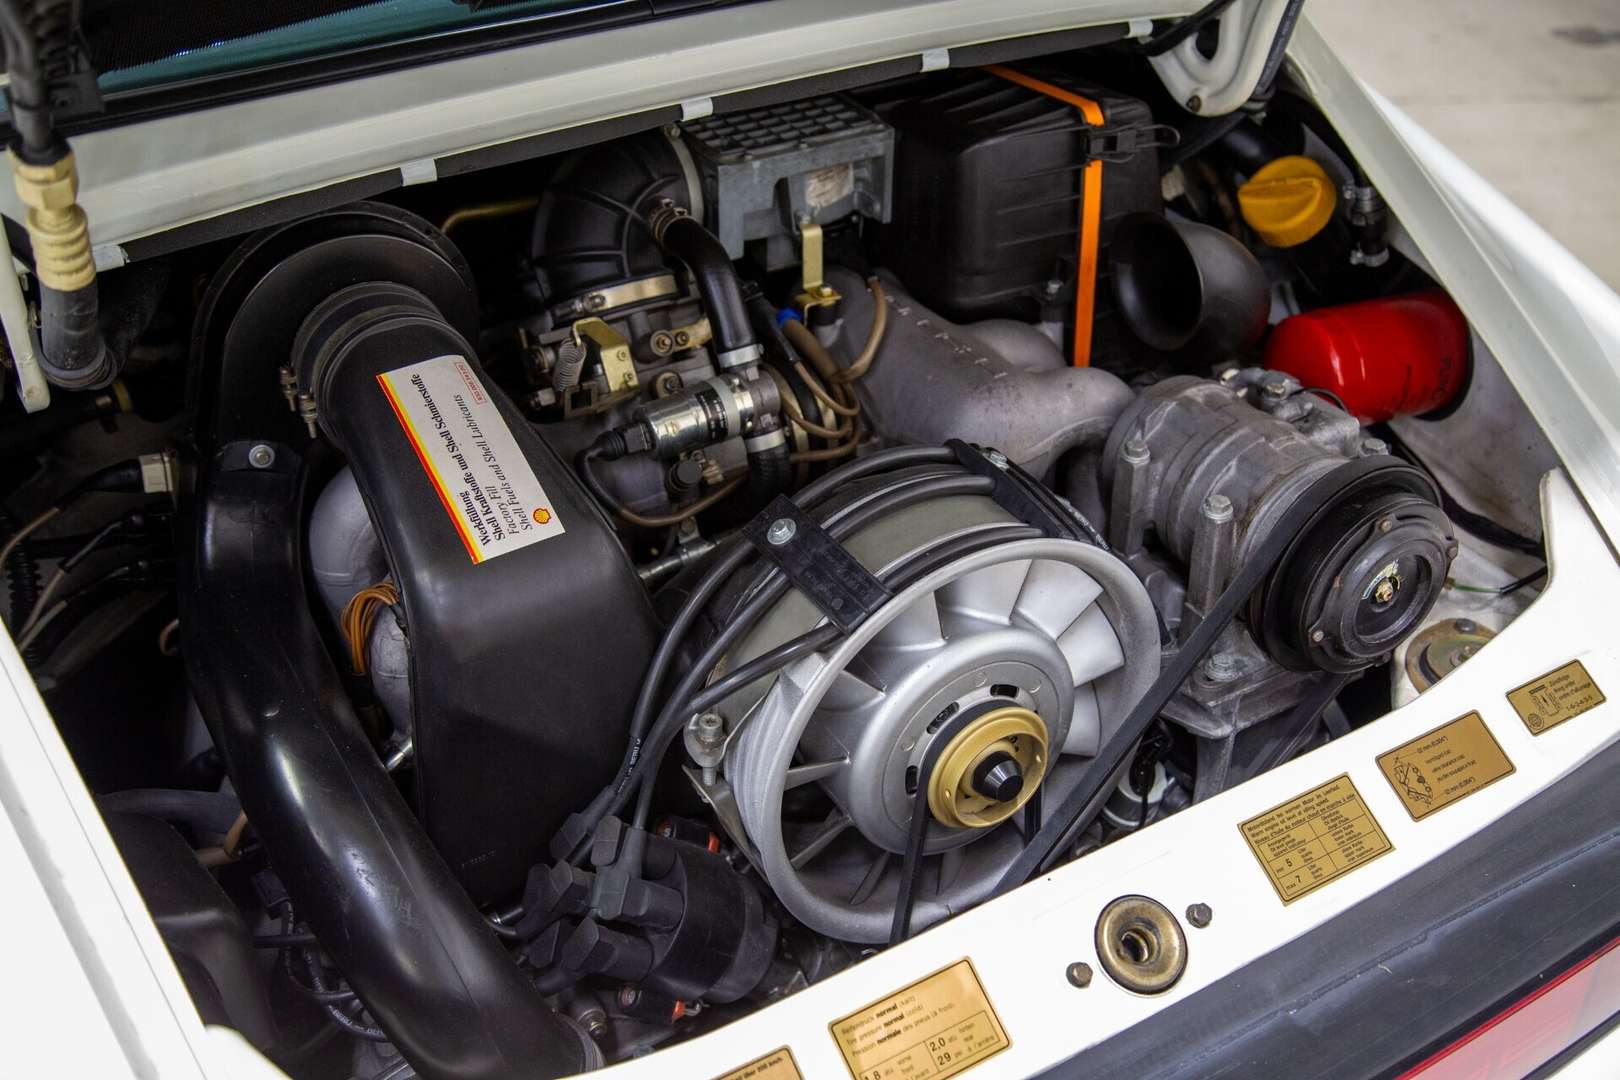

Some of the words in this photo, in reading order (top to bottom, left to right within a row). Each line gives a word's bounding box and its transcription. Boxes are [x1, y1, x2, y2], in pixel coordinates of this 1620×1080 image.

[411, 374, 446, 429] Schmierstoffe
[454, 395, 483, 438] Lubricants
[439, 430, 459, 453] Shell
[476, 441, 495, 462] Shell
[452, 453, 468, 470] und
[488, 464, 505, 480] and
[463, 472, 492, 516] Kraftstoffe
[485, 486, 501, 499] Fill
[501, 483, 519, 505] Fuels
[459, 491, 491, 545] Werkfüllung
[485, 516, 505, 540] Shell
[497, 503, 519, 534] Factory
[512, 508, 532, 530] Shell
[1284, 857, 1293, 867] 5
[1294, 874, 1302, 883] 7
[874, 1003, 898, 1018] normal
[882, 1013, 905, 1027] normal
[876, 1028, 901, 1044] normale
[936, 1051, 952, 1065] 29
